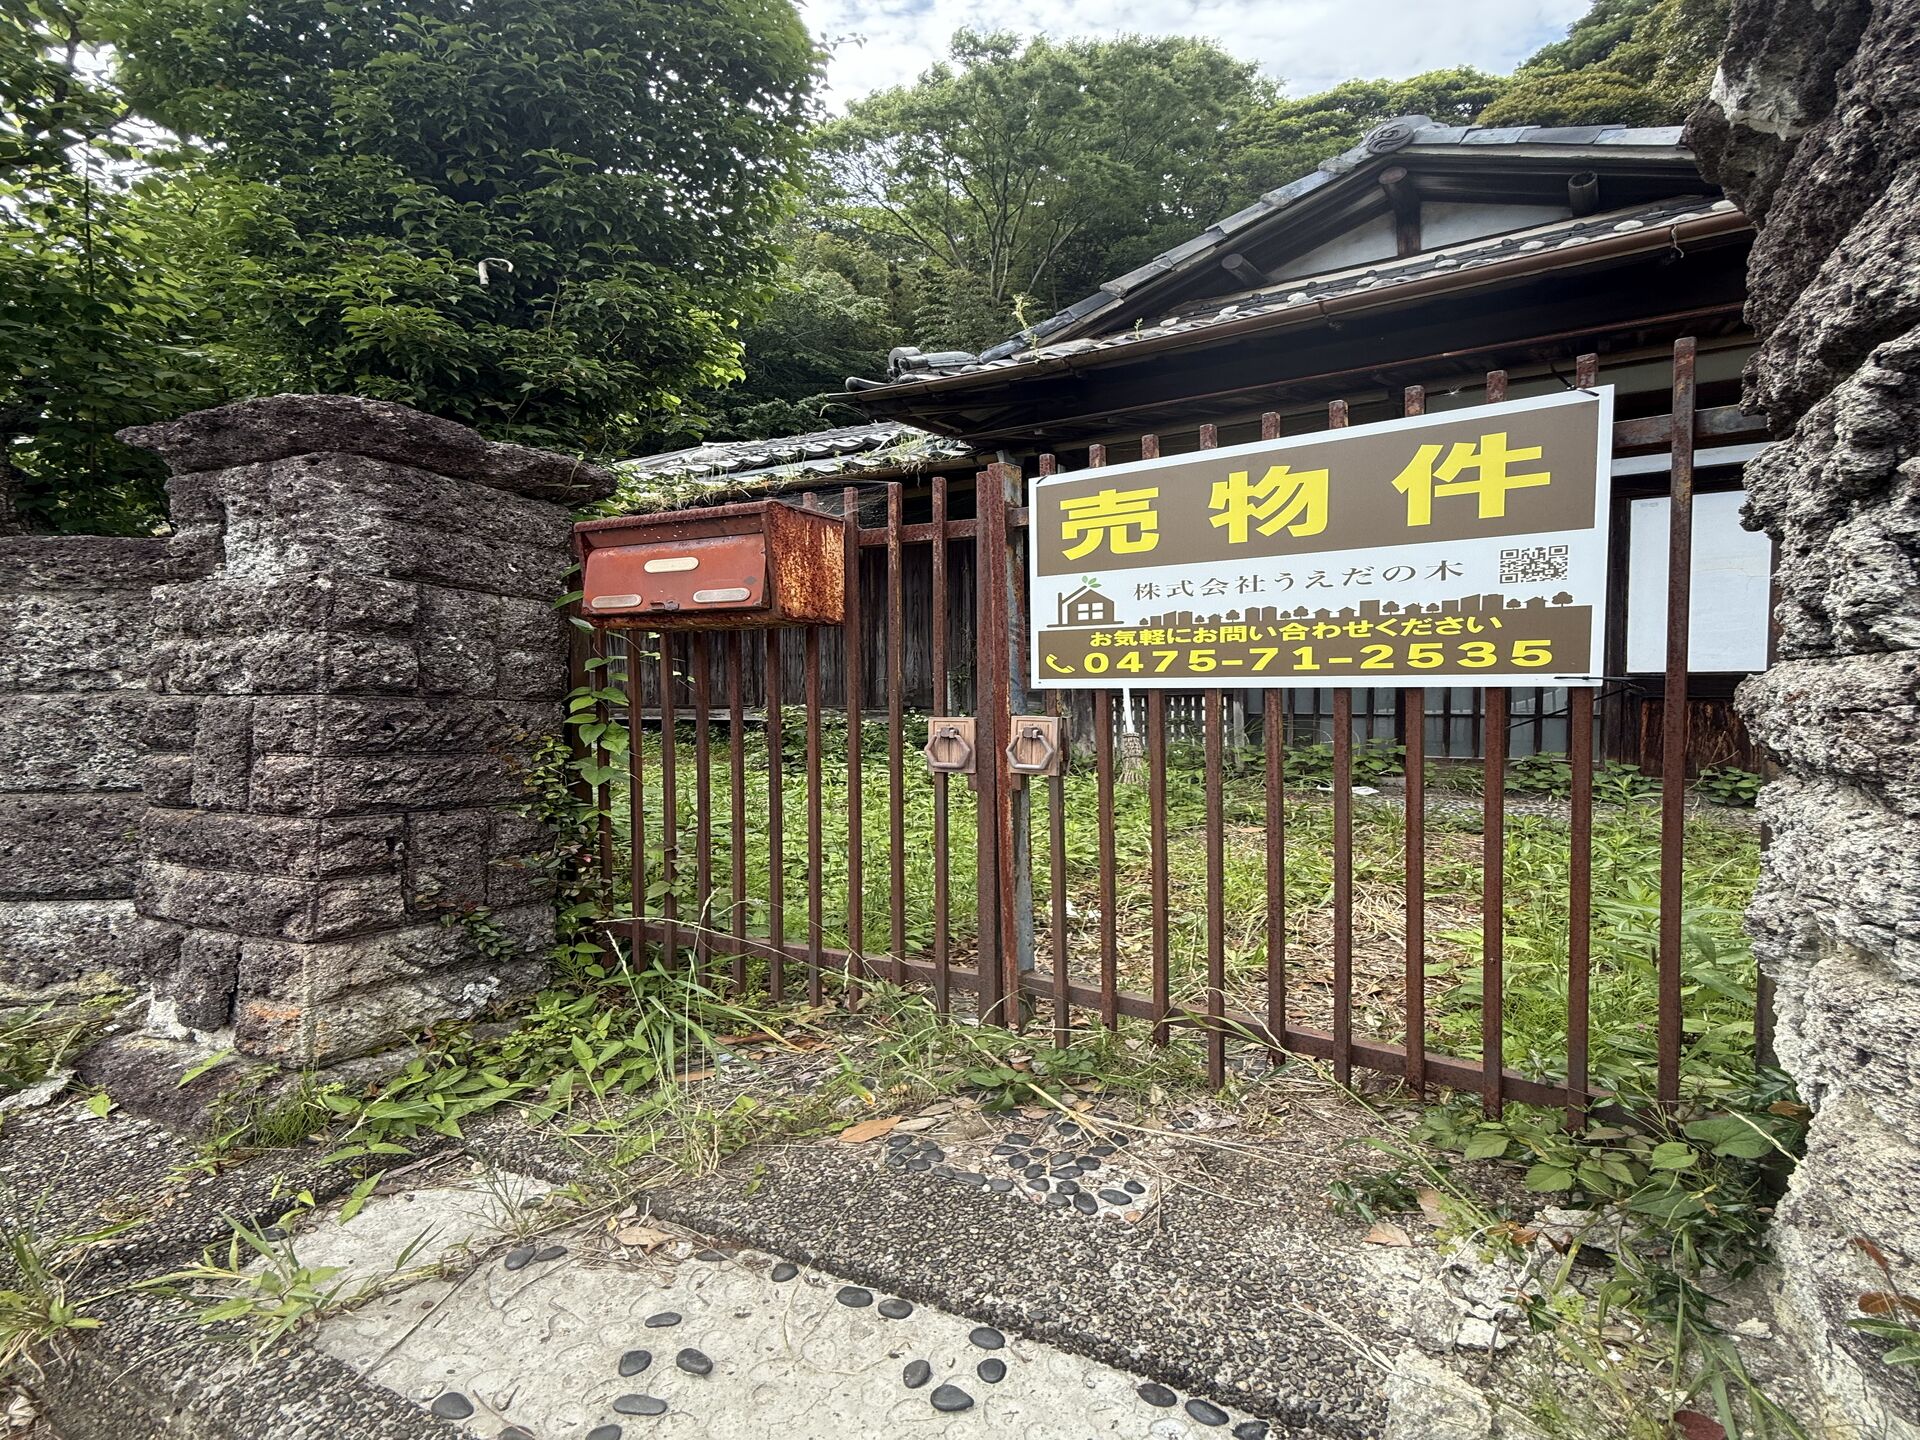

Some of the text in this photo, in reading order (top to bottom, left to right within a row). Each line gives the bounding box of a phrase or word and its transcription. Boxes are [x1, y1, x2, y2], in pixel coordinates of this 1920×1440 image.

[1060, 432, 1551, 560] 売物件
[1133, 560, 1464, 600] 株式会社うえだの木
[1089, 616, 1502, 647] お気軽にお問い合わせください
[1083, 639, 1553, 673] 0475-71-2535
